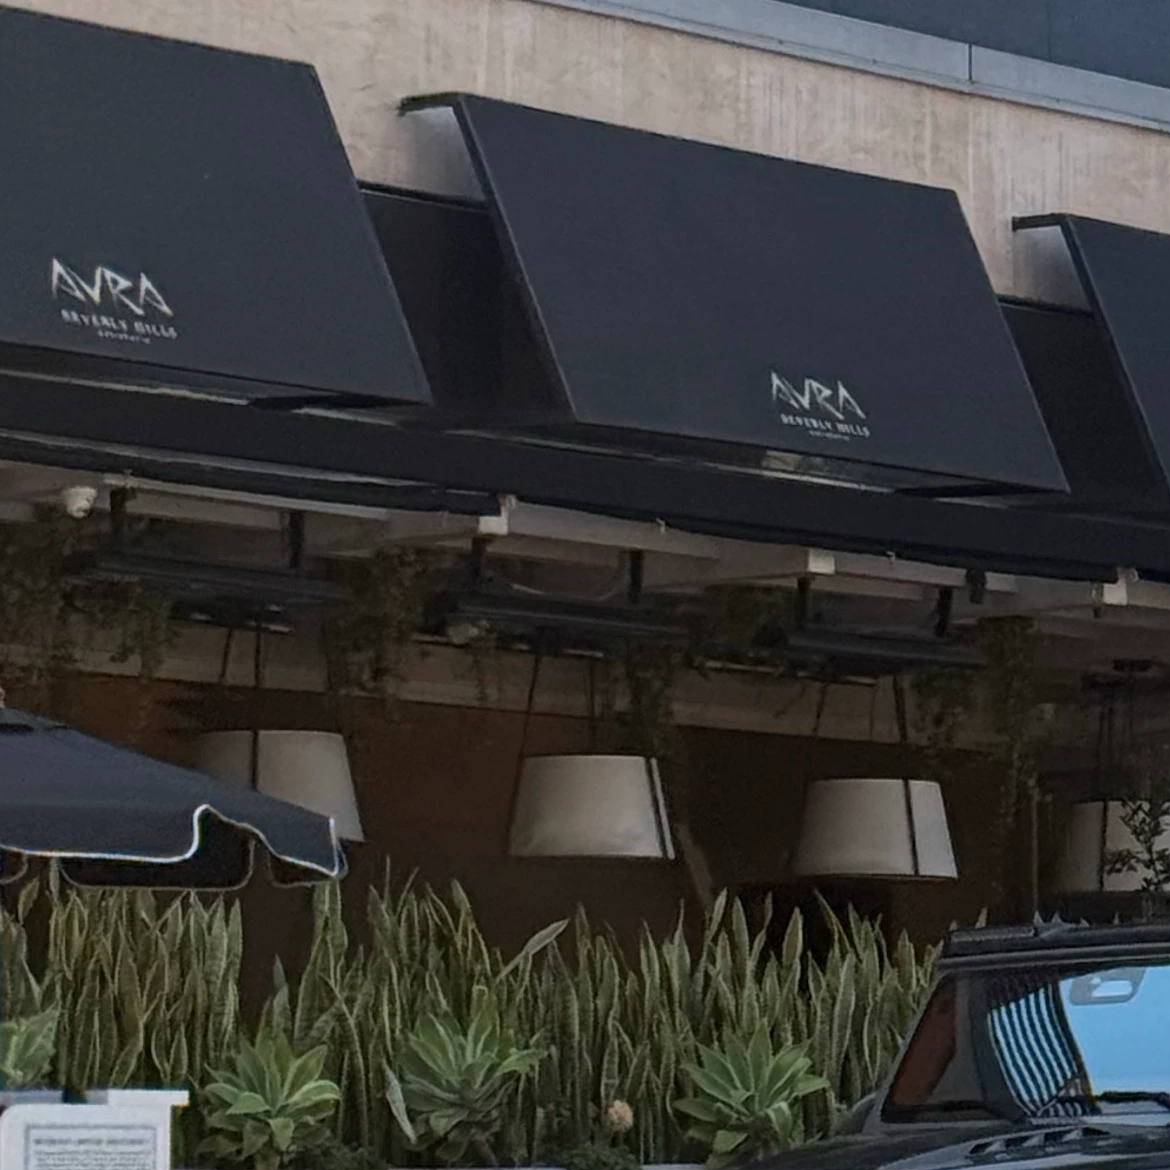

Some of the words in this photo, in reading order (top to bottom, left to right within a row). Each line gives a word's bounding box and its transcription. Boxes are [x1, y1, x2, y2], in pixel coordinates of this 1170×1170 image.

[52, 257, 174, 318] AVRA
[60, 309, 128, 331] BEVERLY
[133, 321, 178, 340] HILLS
[770, 370, 867, 420] AVRA
